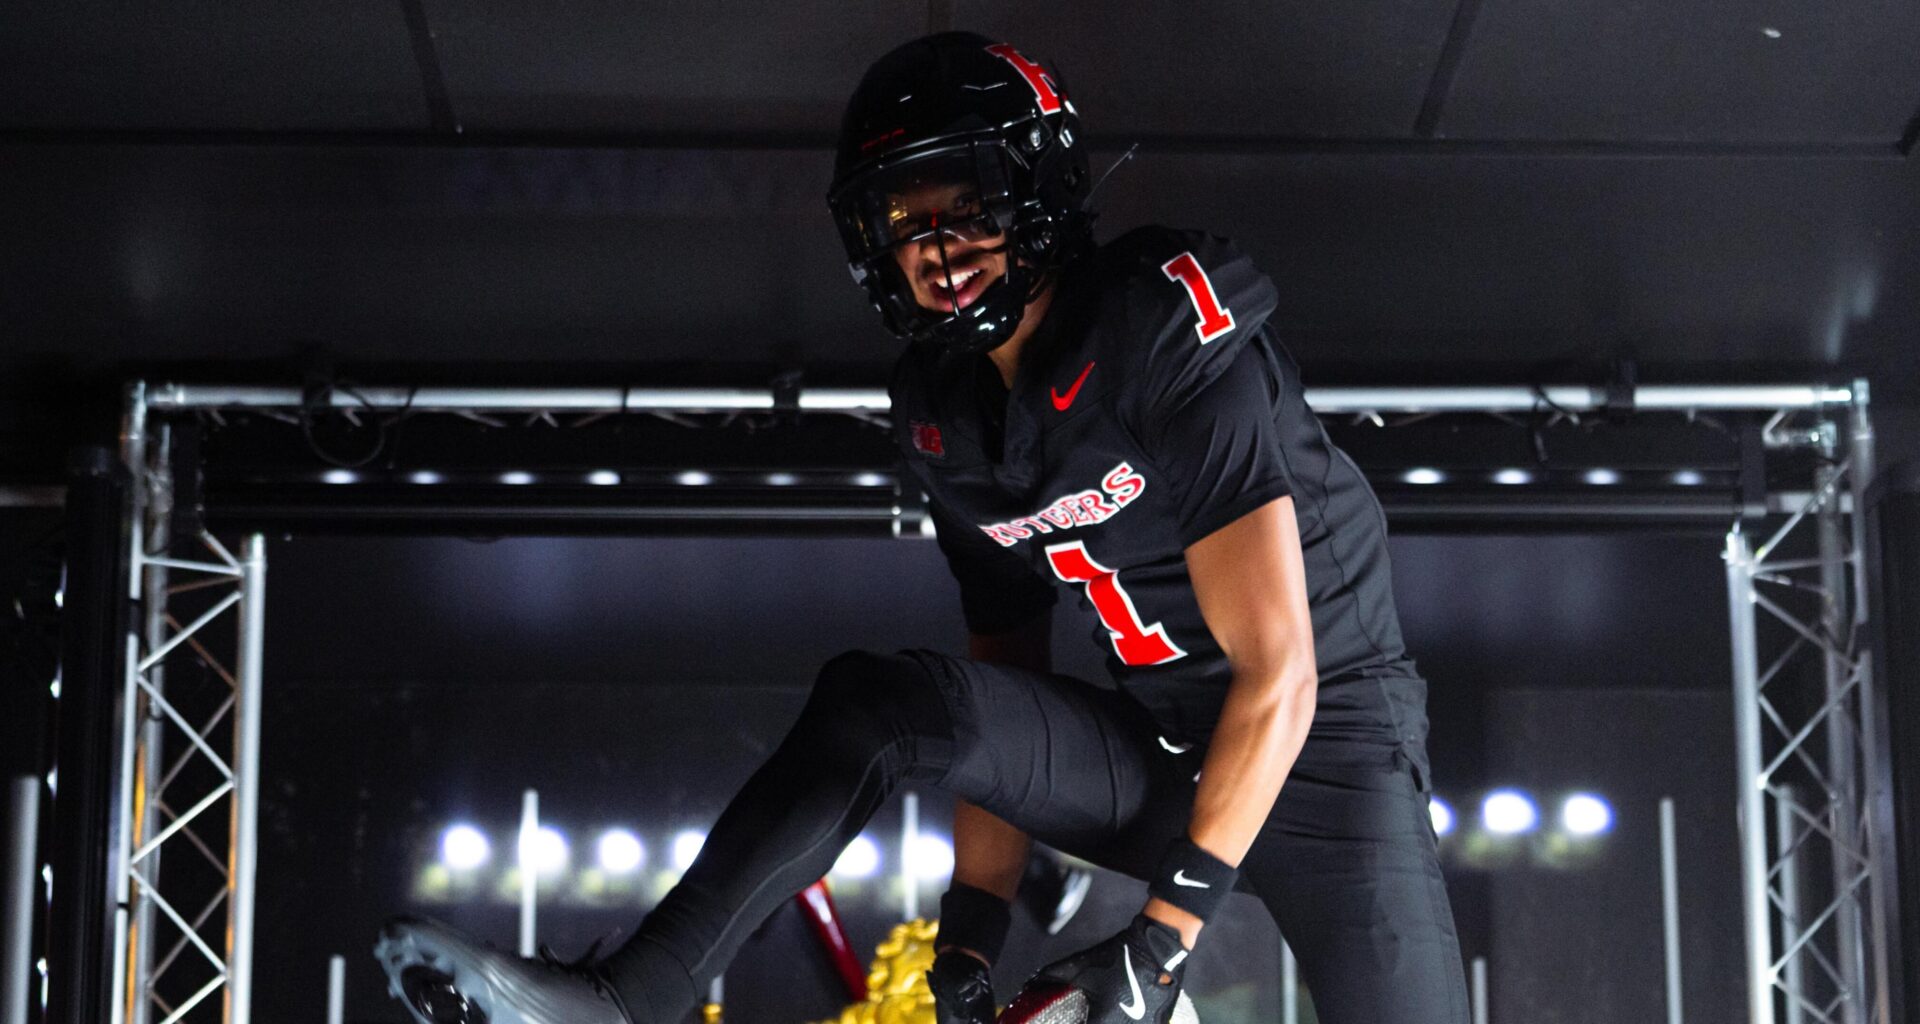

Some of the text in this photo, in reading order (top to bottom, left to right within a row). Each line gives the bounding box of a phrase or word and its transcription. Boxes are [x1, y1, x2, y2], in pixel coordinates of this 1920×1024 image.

[1161, 251, 1236, 345] 1
[978, 461, 1146, 547] RUTGERS
[1045, 540, 1188, 666] 1
